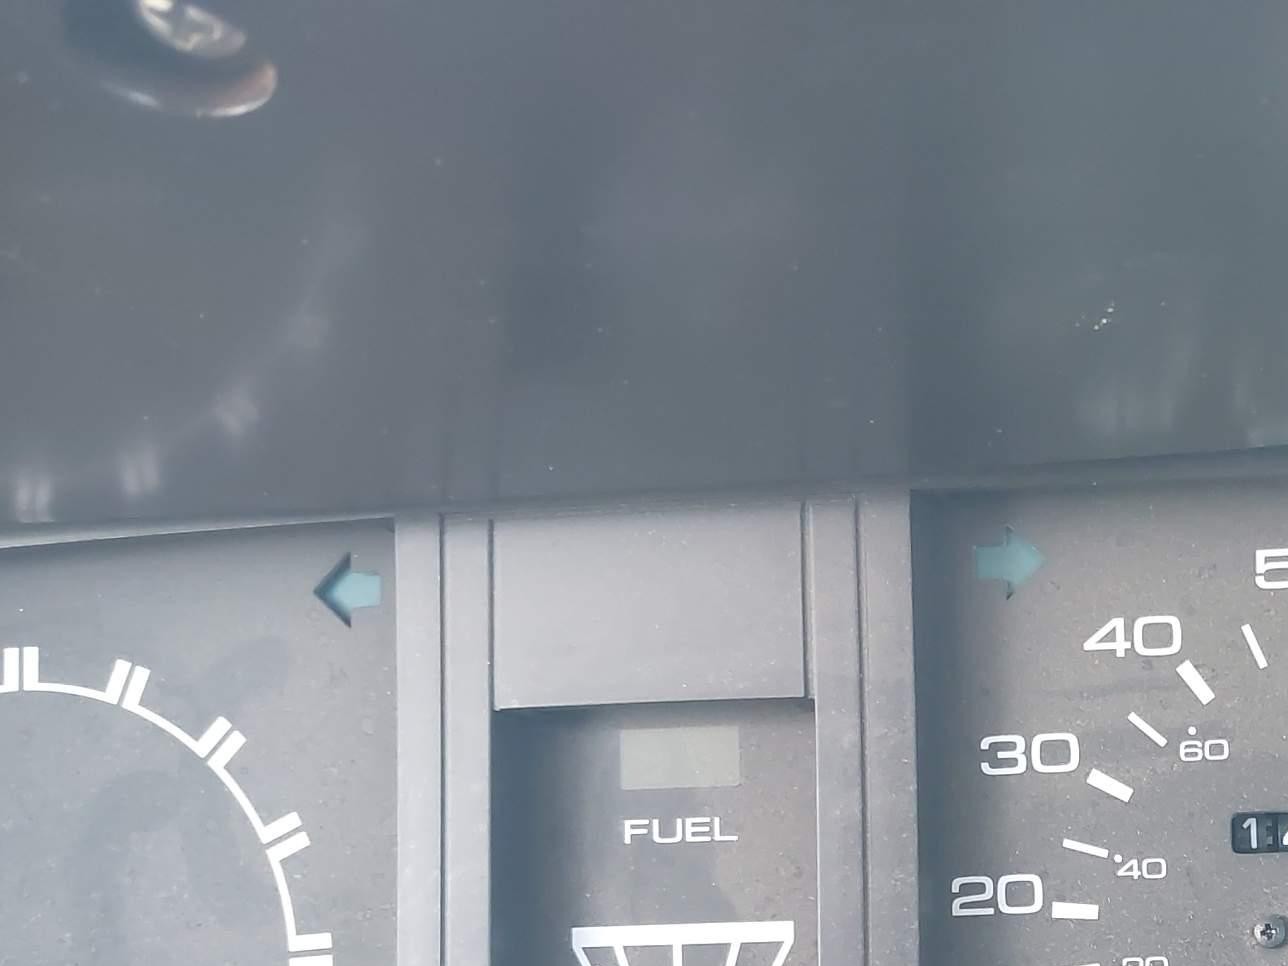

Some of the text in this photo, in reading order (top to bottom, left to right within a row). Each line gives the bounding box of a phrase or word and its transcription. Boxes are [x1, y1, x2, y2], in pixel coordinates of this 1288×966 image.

[1084, 616, 1181, 657] 40
[981, 733, 1079, 774] 30
[1180, 740, 1229, 761] 60
[624, 817, 738, 844] FUEL
[1118, 857, 1167, 880] 40
[952, 874, 1043, 915] 20
